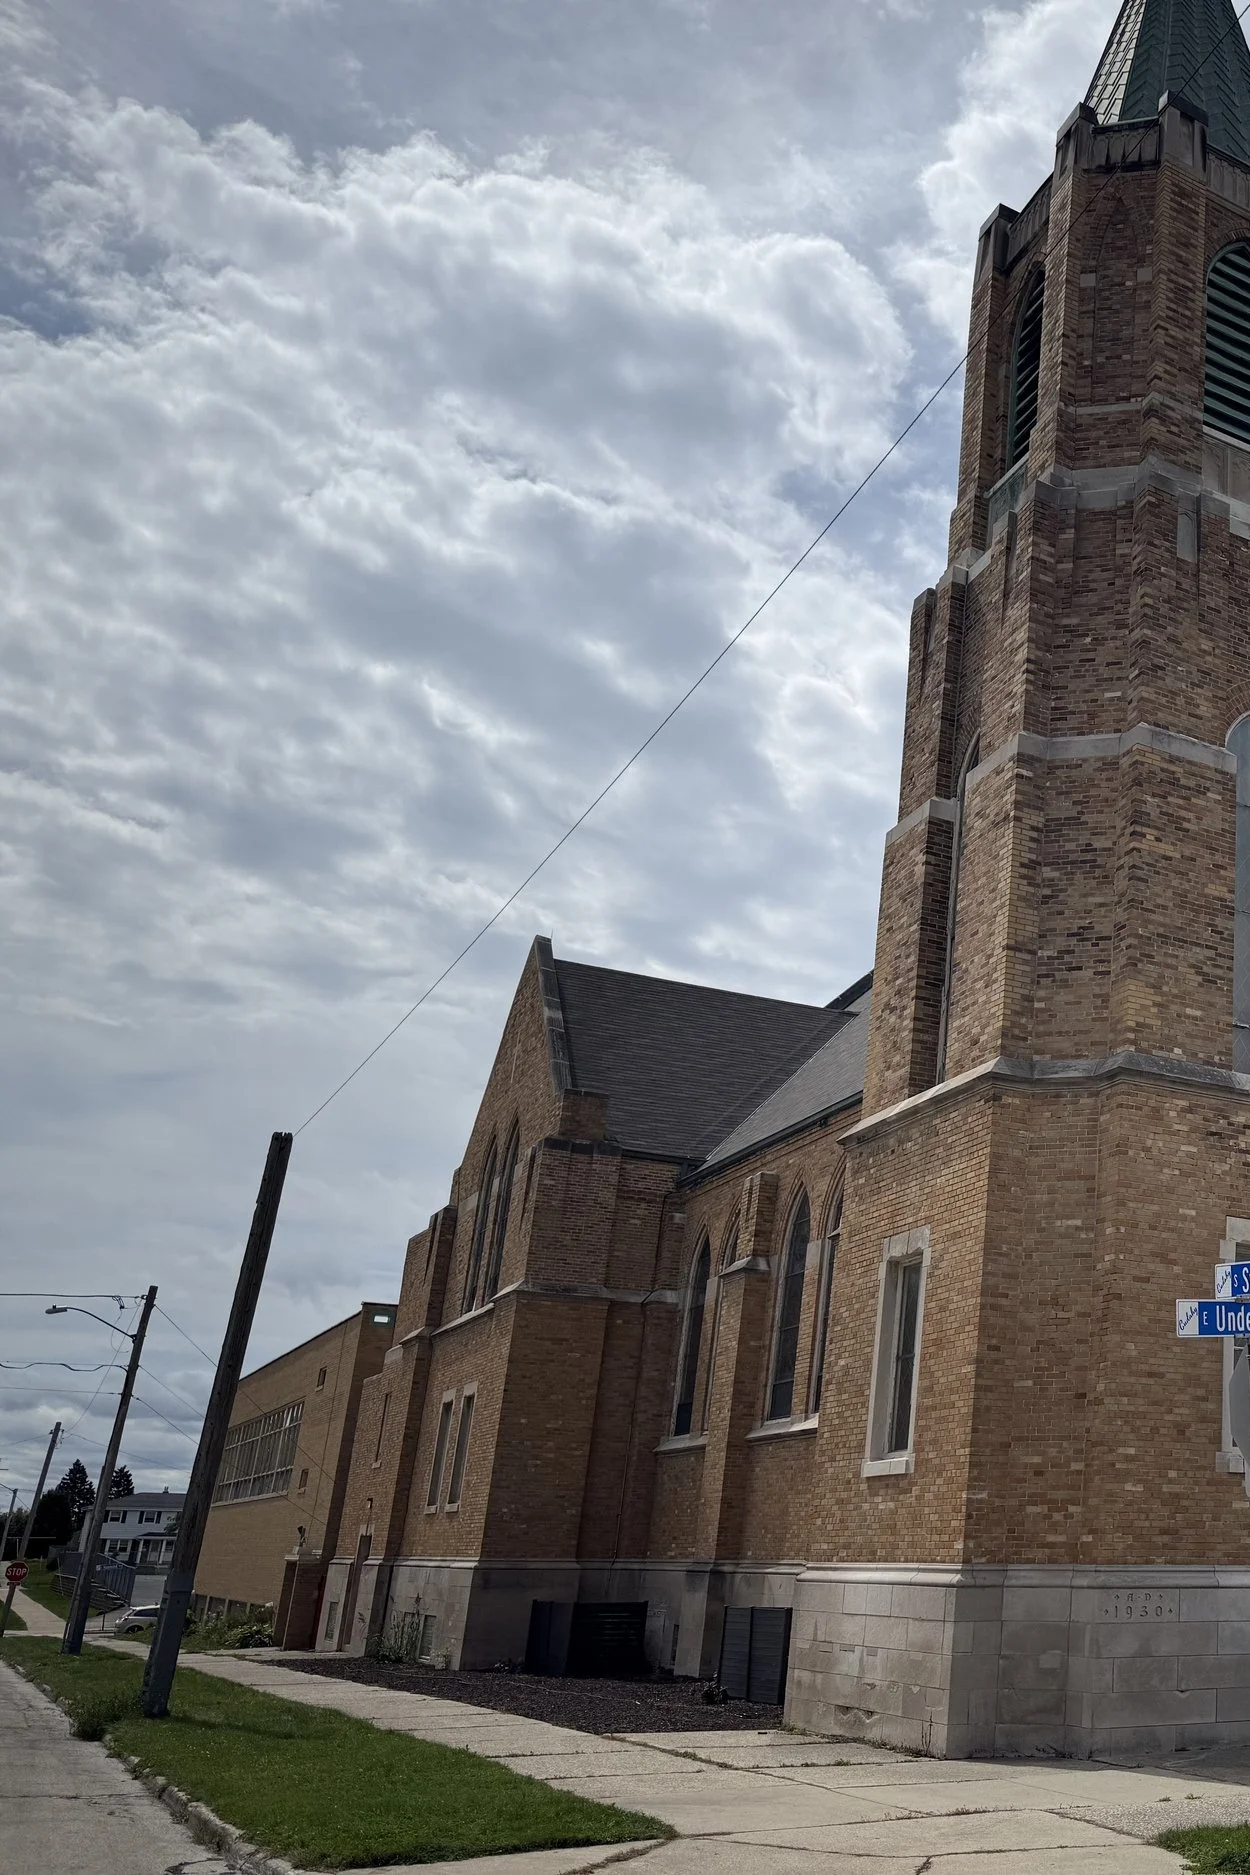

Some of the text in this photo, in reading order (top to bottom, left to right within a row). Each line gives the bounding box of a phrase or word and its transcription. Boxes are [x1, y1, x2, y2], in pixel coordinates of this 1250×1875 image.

[1233, 1273, 1238, 1288] S
[1178, 1305, 1199, 1331] Cudahy
[1203, 1311, 1208, 1326] E
[6, 1567, 27, 1576] STOP
[1115, 1605, 1163, 1619] 1930
